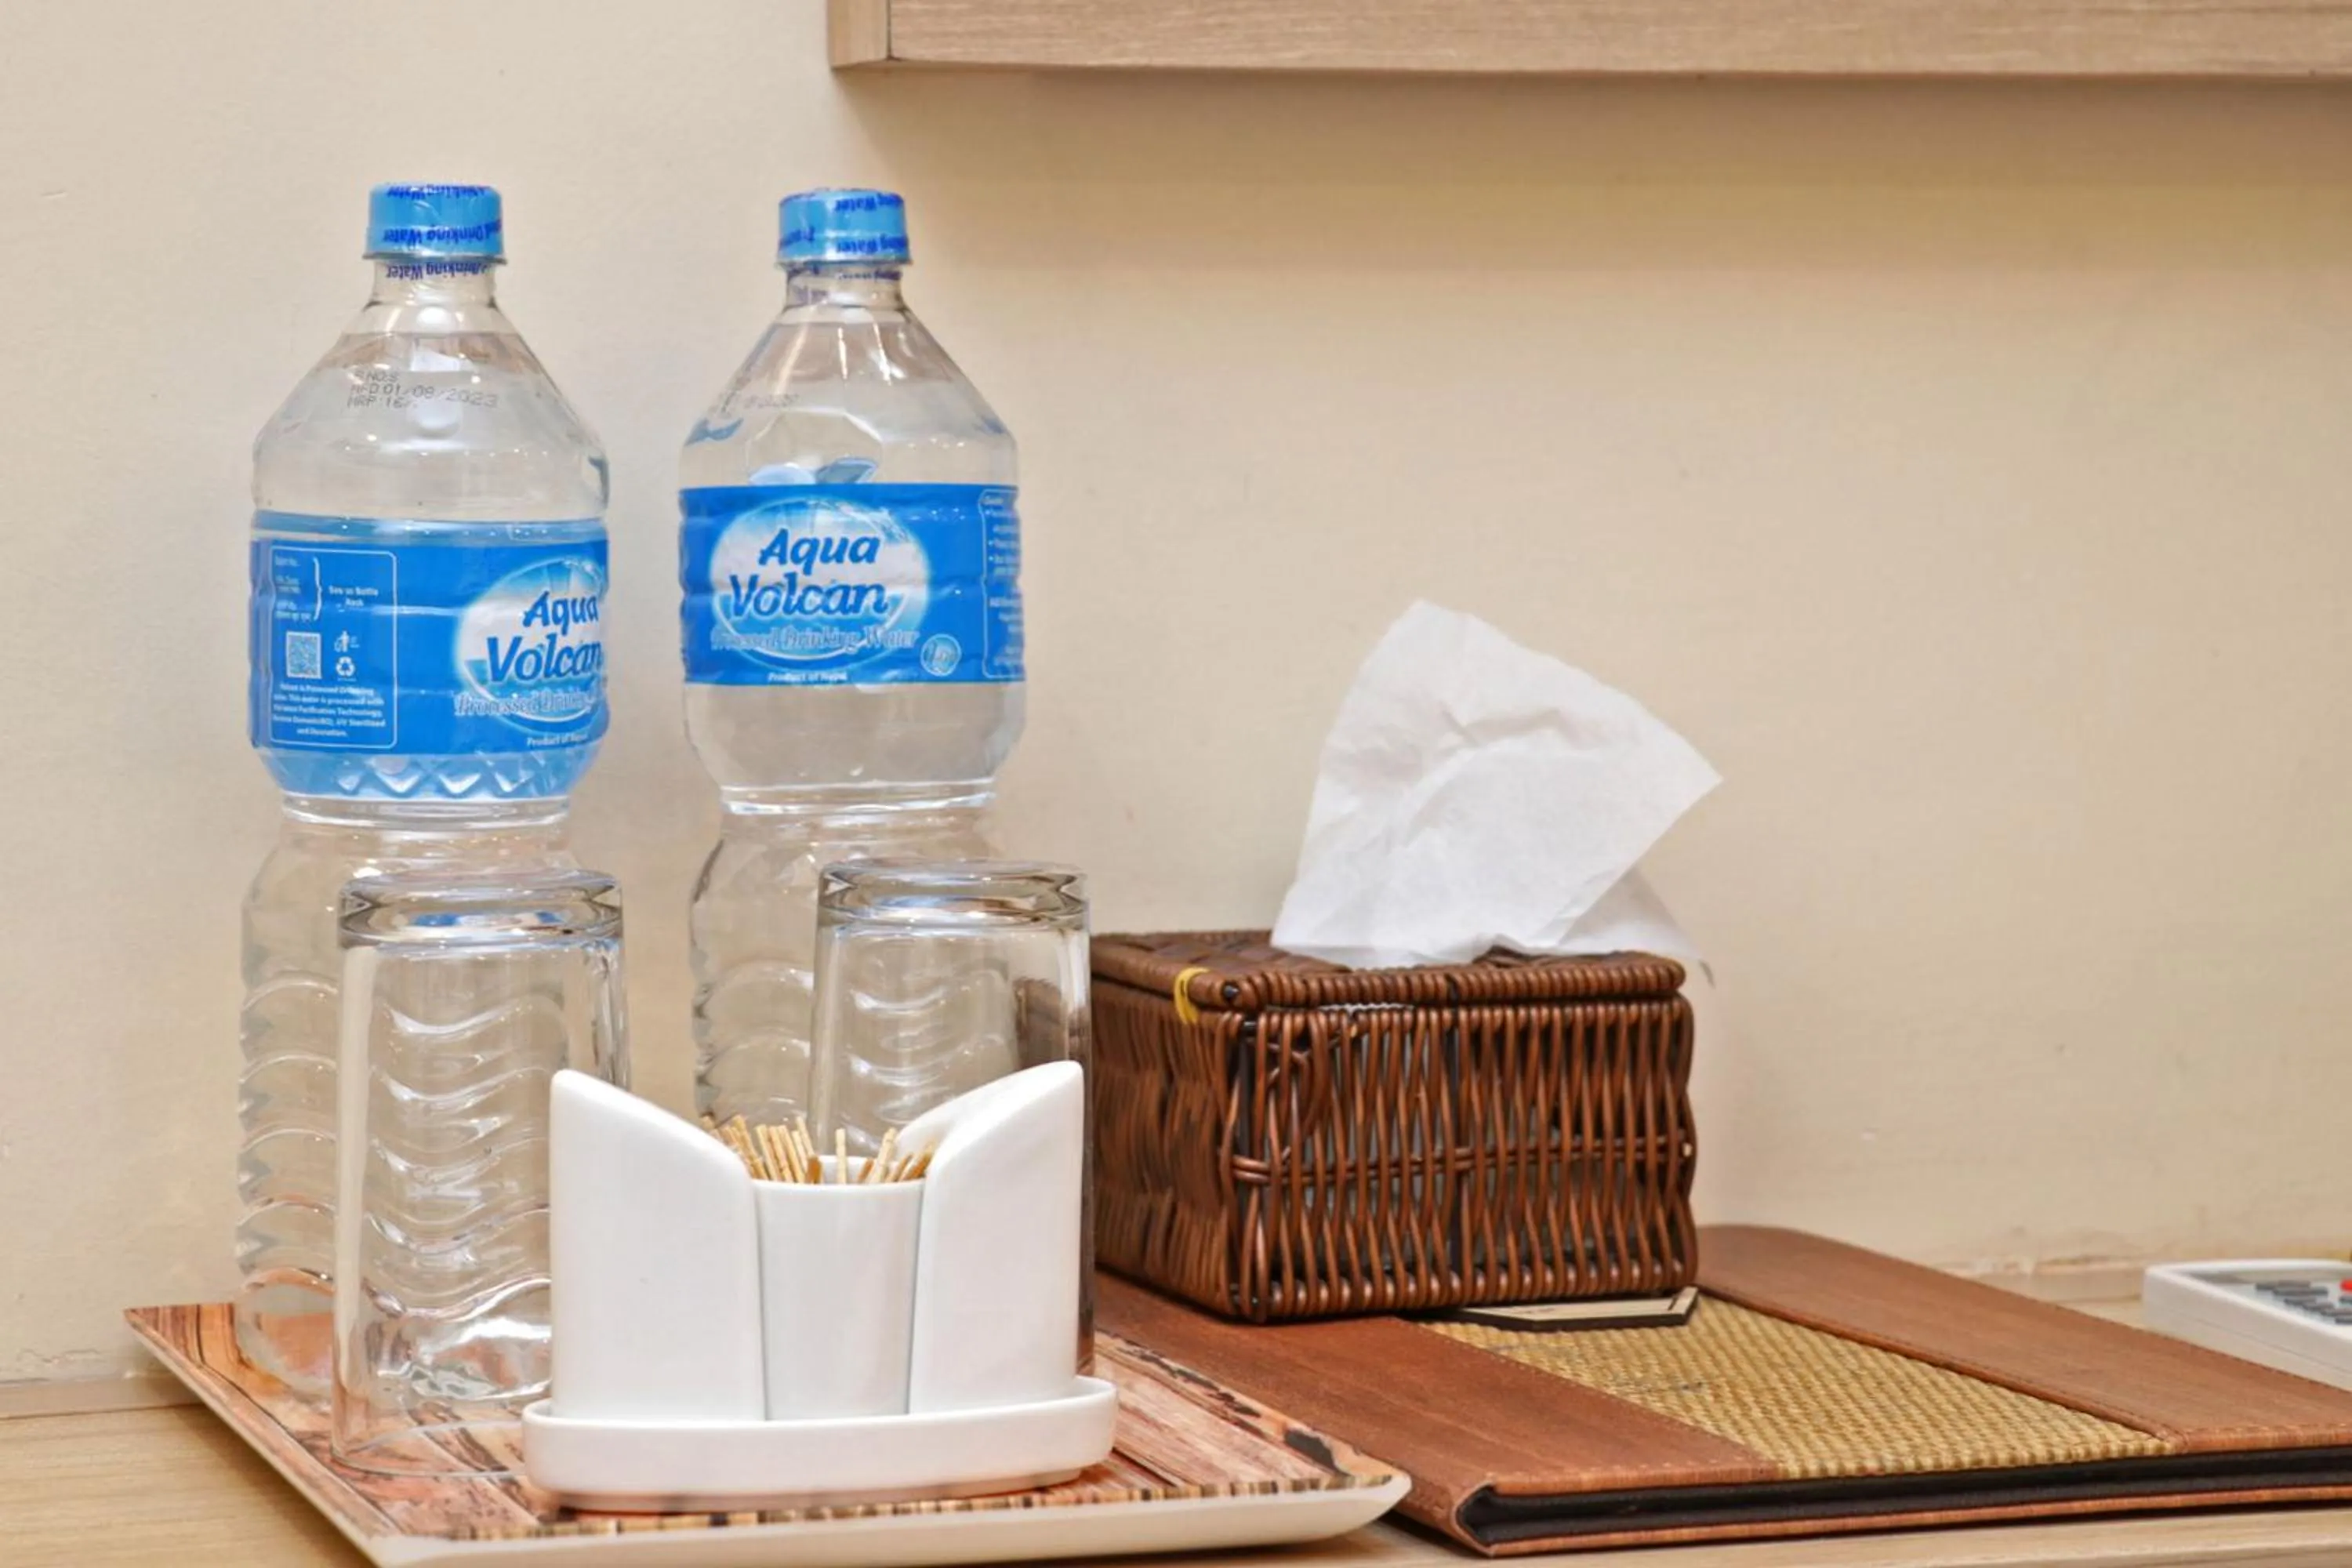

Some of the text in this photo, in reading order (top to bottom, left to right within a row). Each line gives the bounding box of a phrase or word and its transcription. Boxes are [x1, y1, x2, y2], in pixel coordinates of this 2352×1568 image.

[387, 263, 423, 280] Water
[758, 527, 880, 575] Aqua
[522, 591, 598, 636] Aqua
[730, 572, 887, 617] Volcan
[487, 633, 602, 681] Volcan
[783, 625, 862, 654] Drinking
[865, 626, 920, 648] Water
